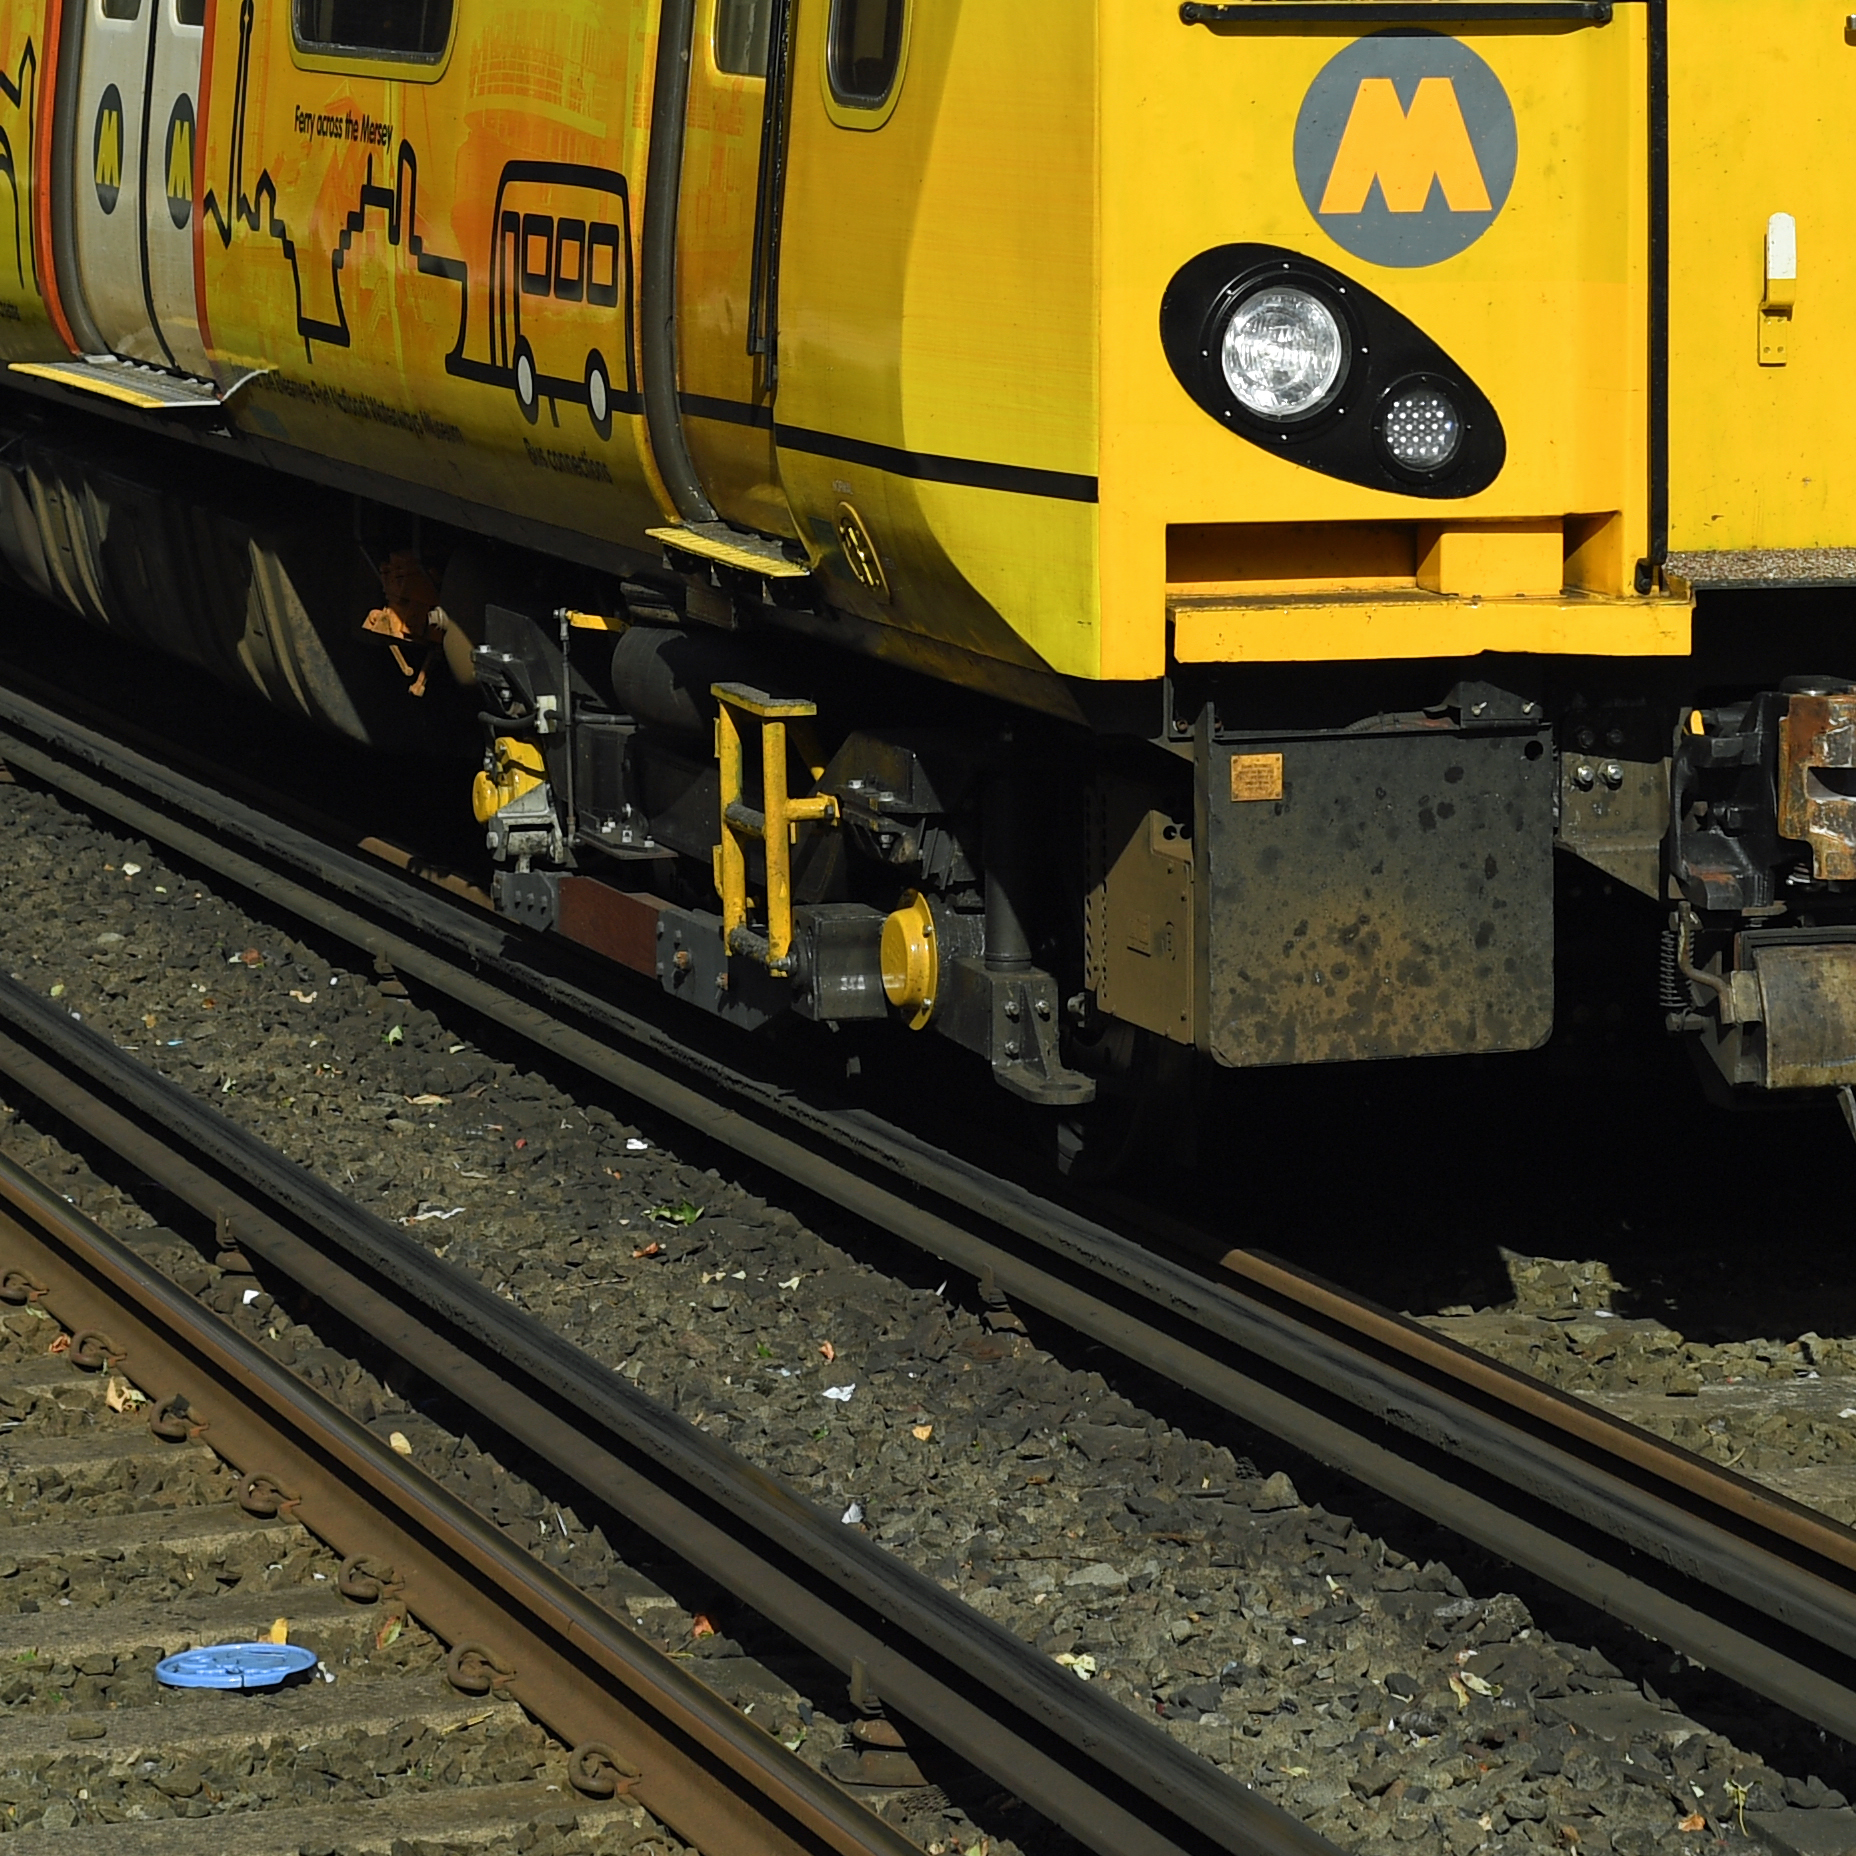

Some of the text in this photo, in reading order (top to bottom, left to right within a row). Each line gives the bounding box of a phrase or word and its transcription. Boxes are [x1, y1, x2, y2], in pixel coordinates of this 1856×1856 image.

[98, 109, 121, 186] M
[167, 121, 192, 202] M
[294, 104, 393, 155] Ferry across the Mersey
[1319, 77, 1492, 213] M
[523, 437, 613, 485] Bus connections
